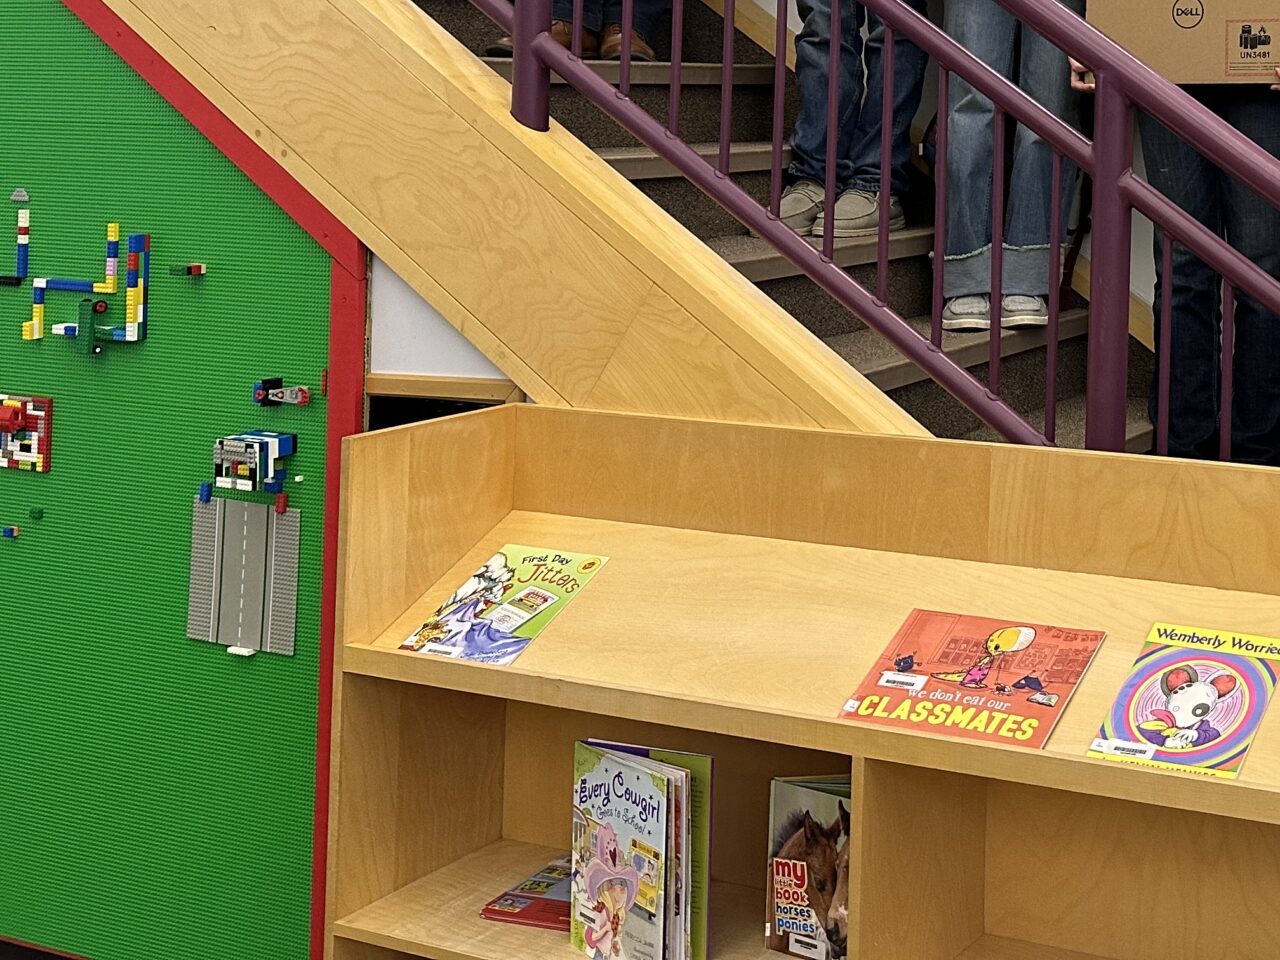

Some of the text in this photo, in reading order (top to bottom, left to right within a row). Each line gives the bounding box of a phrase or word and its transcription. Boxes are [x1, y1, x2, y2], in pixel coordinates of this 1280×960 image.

[1176, 7, 1201, 17] DELL
[1240, 51, 1271, 59] UN3481
[521, 554, 573, 566] First Day
[517, 563, 580, 594] Jitters
[1156, 628, 1227, 649] Wemberly
[908, 688, 1012, 711] we don't eat our
[857, 694, 1040, 741] CLASSMATES
[579, 778, 611, 807] Every
[612, 771, 661, 823] Cowgirl
[596, 806, 647, 835] Goes to School
[775, 859, 806, 889] my
[775, 879, 794, 888] little
[775, 887, 808, 904] book
[776, 902, 811, 919] horses
[777, 918, 815, 933] ponies
